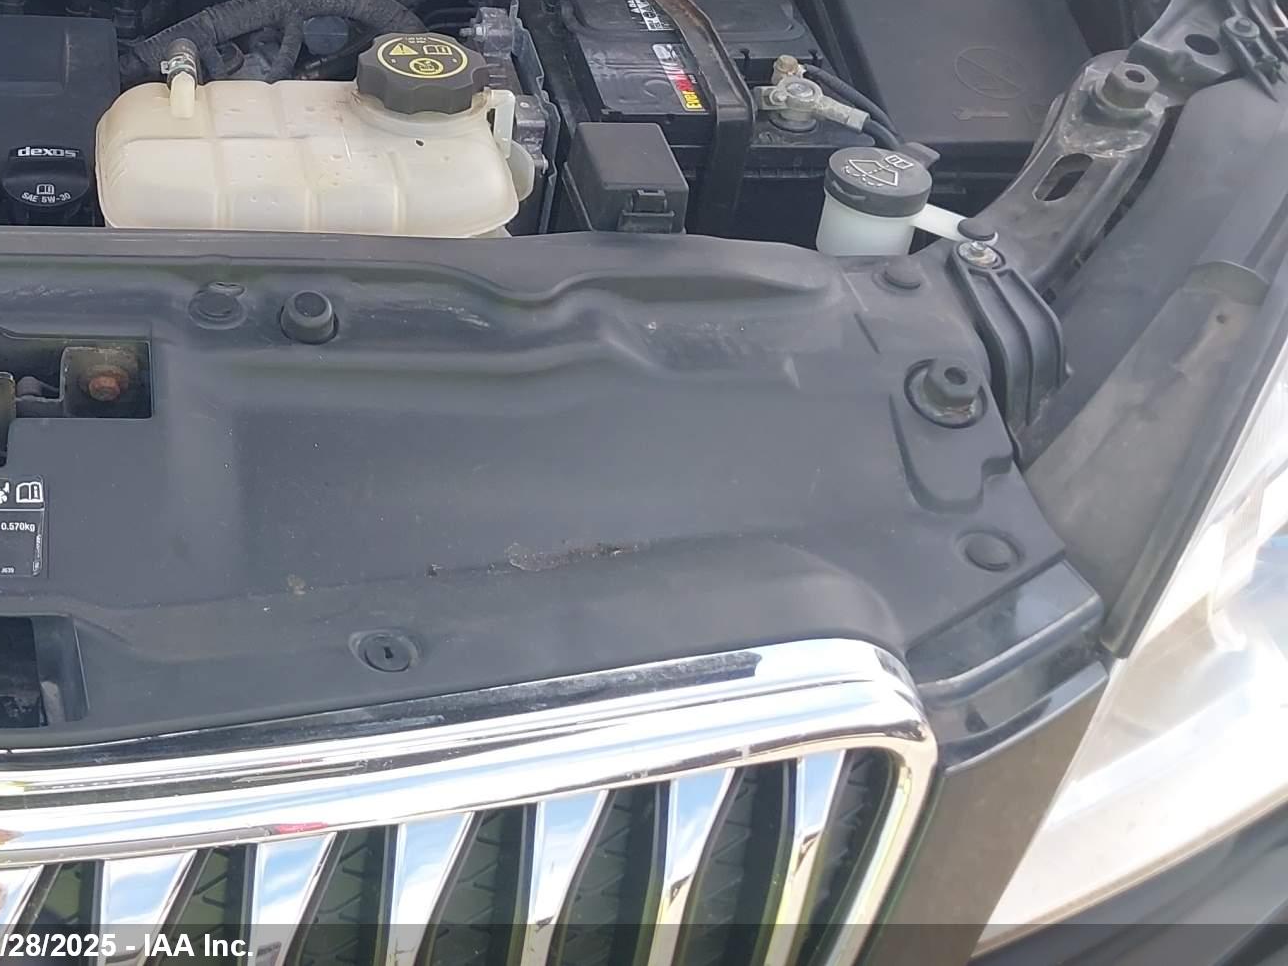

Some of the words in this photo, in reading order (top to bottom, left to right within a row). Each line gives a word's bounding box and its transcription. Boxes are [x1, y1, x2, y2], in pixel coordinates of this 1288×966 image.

[17, 146, 80, 158] dexos
[21, 192, 39, 203] SAE
[41, 192, 71, 204] 5W-30
[0, 521, 36, 532] 0.570kg
